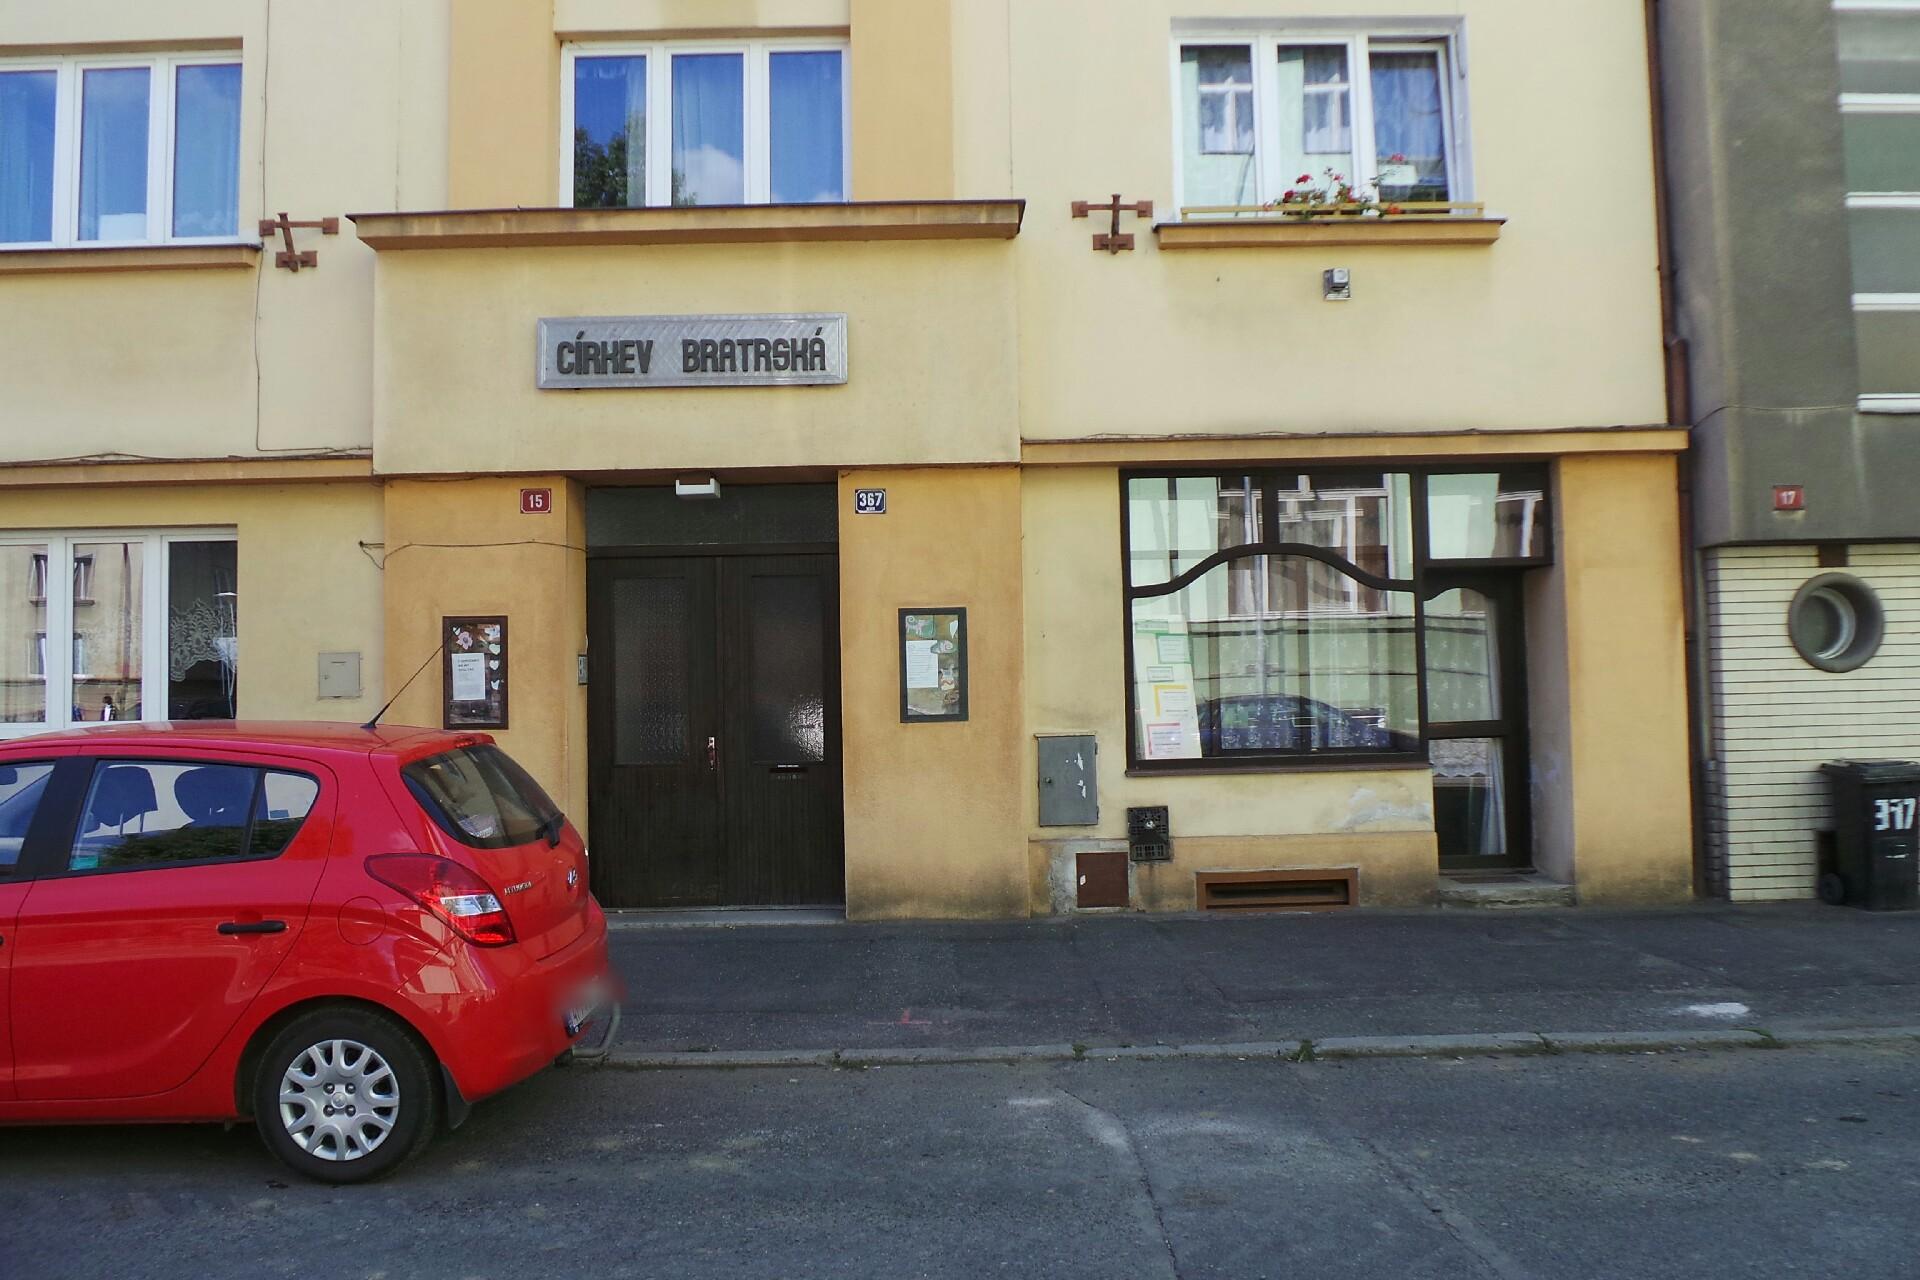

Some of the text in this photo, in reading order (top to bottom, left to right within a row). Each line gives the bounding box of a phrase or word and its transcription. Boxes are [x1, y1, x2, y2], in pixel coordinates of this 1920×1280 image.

[556, 327, 826, 375] CÍRKEV BRATRSKÁ
[529, 494, 543, 508] 15
[859, 492, 883, 506] 367
[1781, 491, 1796, 505] 17
